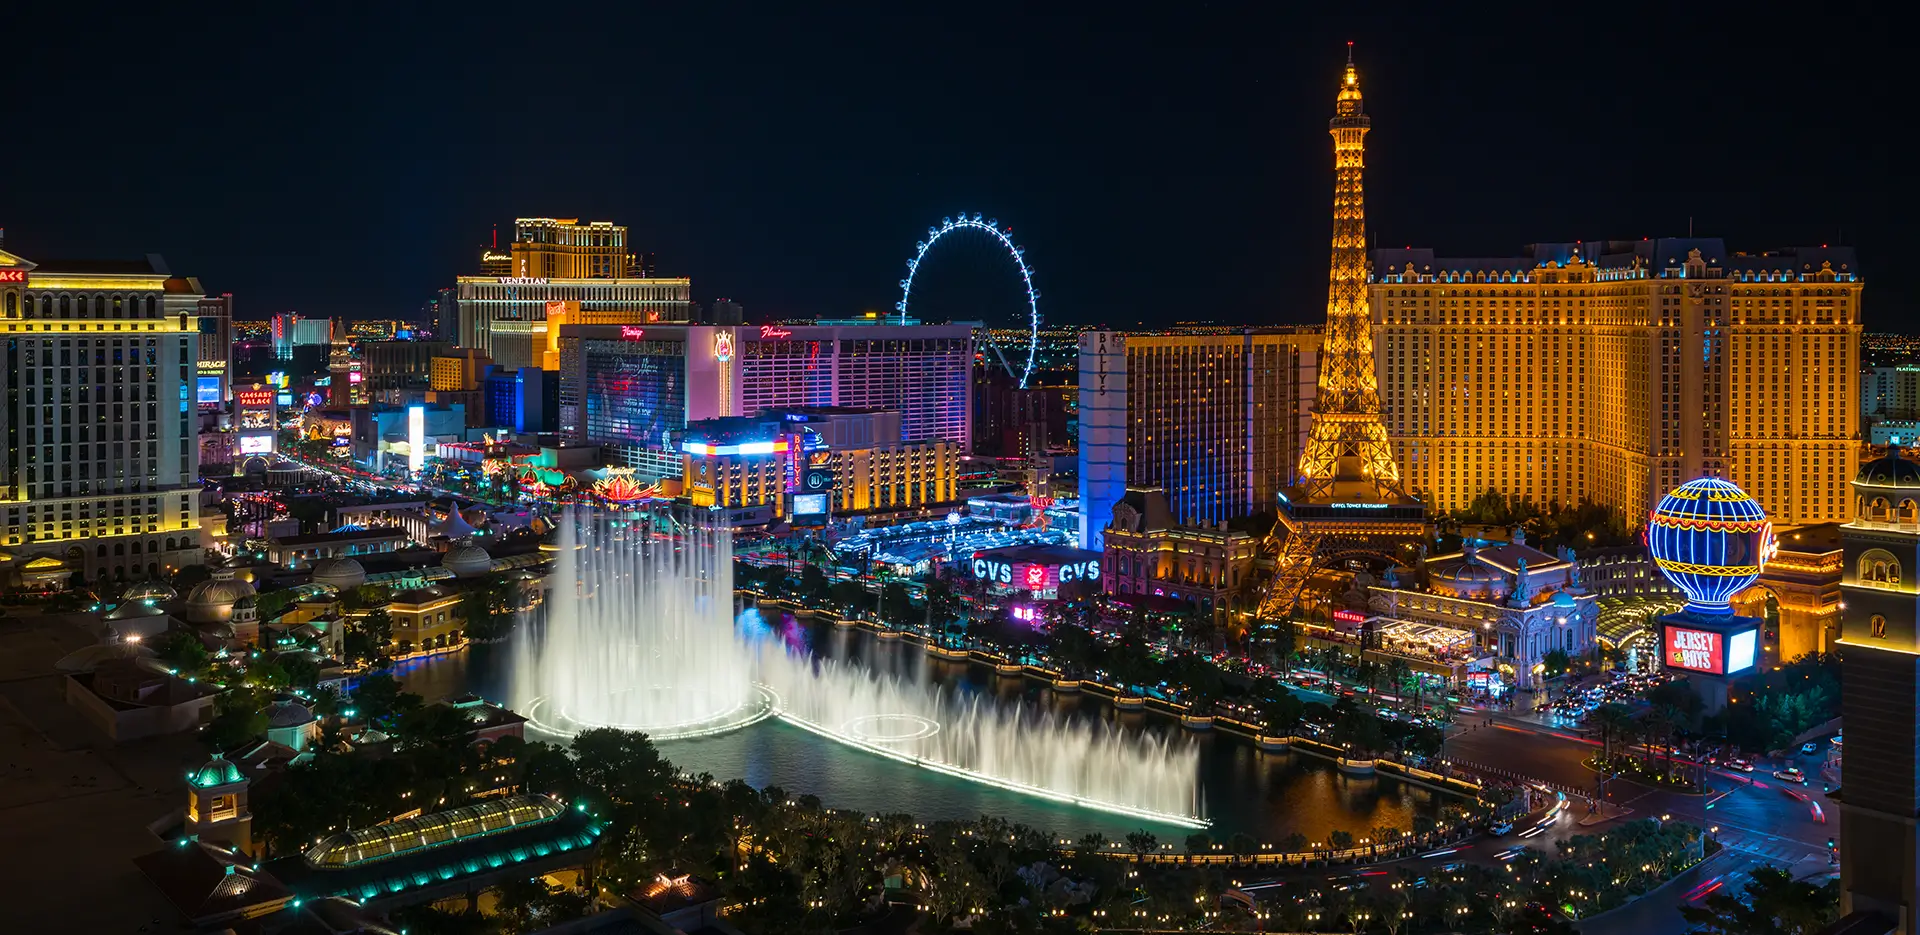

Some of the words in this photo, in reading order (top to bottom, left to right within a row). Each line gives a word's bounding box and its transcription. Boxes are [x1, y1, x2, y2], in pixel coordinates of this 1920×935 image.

[483, 251, 513, 261] Encore
[622, 325, 644, 340] Flamingo
[760, 325, 792, 339] Flamingo
[974, 559, 1012, 583] CVS
[1059, 560, 1100, 584] CVS
[1334, 611, 1349, 619] BEER
[1349, 614, 1365, 622] PARK
[1673, 630, 1714, 652] JERSEY
[1682, 649, 1711, 669] BOYS
